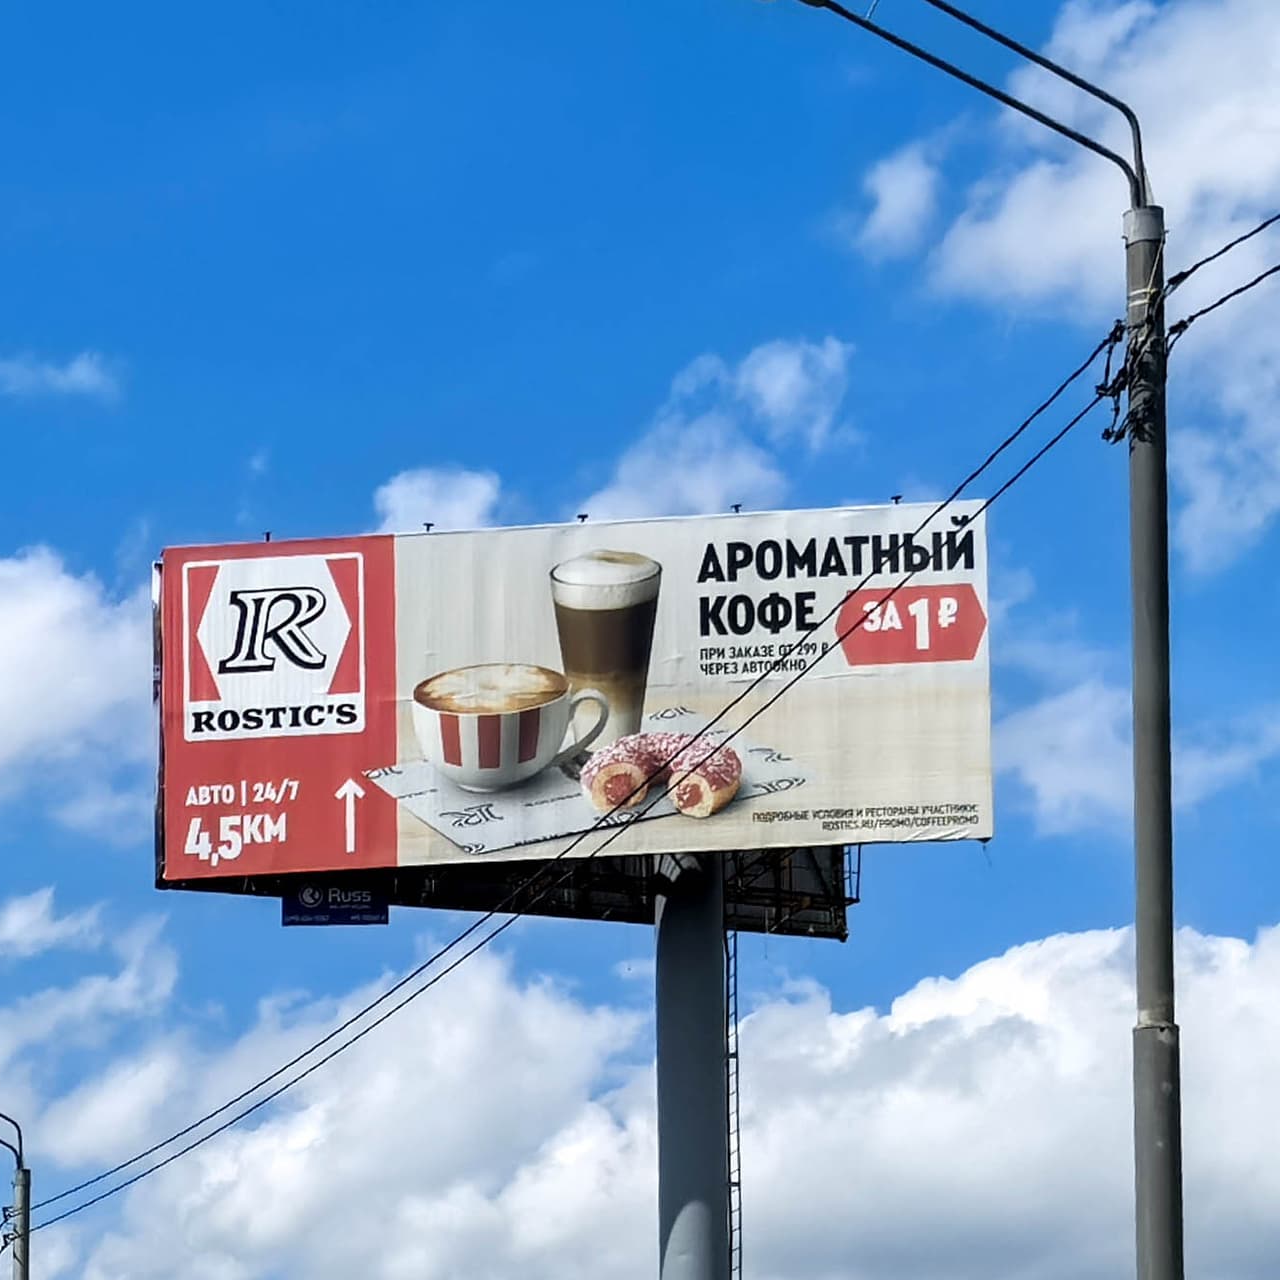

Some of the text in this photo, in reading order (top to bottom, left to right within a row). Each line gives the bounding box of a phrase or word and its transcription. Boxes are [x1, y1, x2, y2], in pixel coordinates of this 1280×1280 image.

[697, 515, 974, 583] АРОМАТНЫЙ
[699, 591, 818, 637] КОФЕ
[863, 601, 903, 633] ЗА
[700, 646, 726, 661] ПРИ
[728, 644, 775, 660] ЗАКАЗЕ
[778, 642, 795, 657] ОТ
[797, 641, 818, 656] 299
[700, 657, 808, 676] ЧЕРЕЗ АВТООКНО
[191, 703, 358, 733] ROSTIC'S
[185, 785, 236, 807] АВТО
[252, 778, 300, 804] 24/7
[328, 887, 372, 903] Russ
